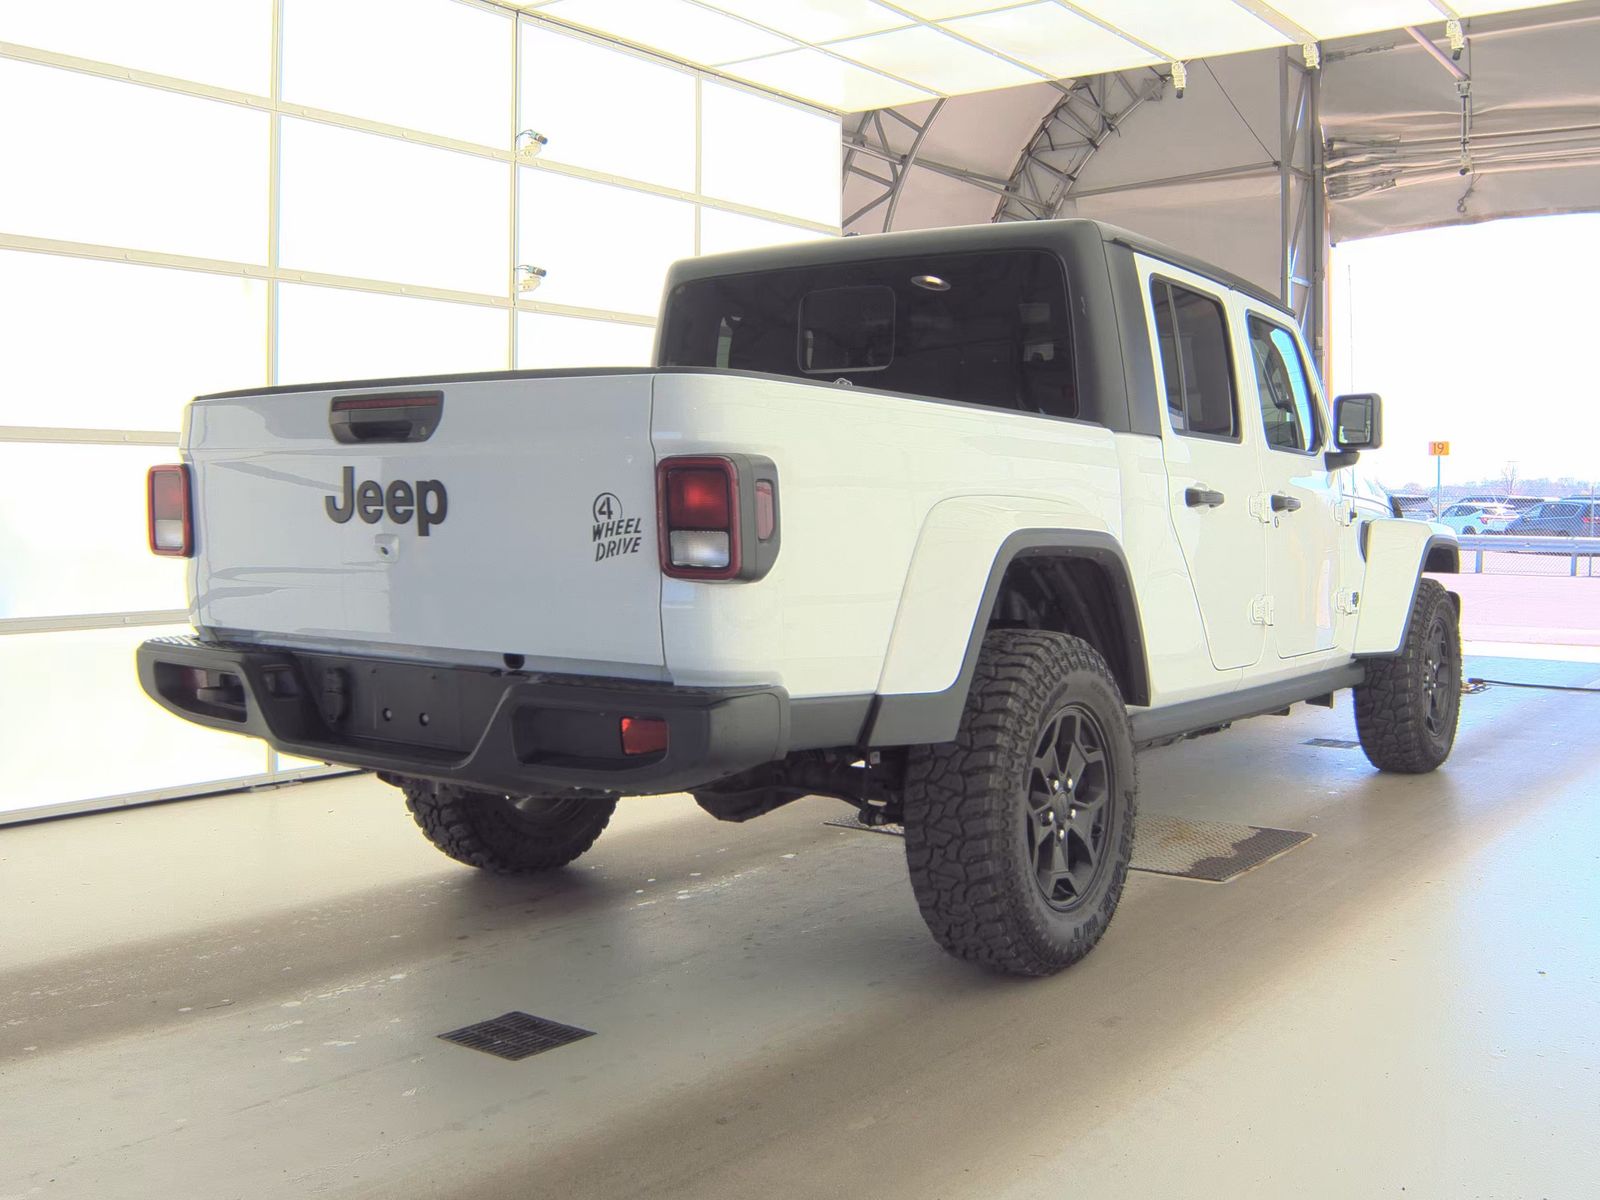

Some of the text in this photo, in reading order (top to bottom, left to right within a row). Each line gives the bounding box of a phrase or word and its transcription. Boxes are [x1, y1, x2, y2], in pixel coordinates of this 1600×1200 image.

[1433, 442, 1445, 455] 19
[325, 466, 448, 536] Jeep
[597, 497, 613, 520] 4
[593, 518, 642, 542] WHEEL
[595, 537, 642, 562] DRIVE
